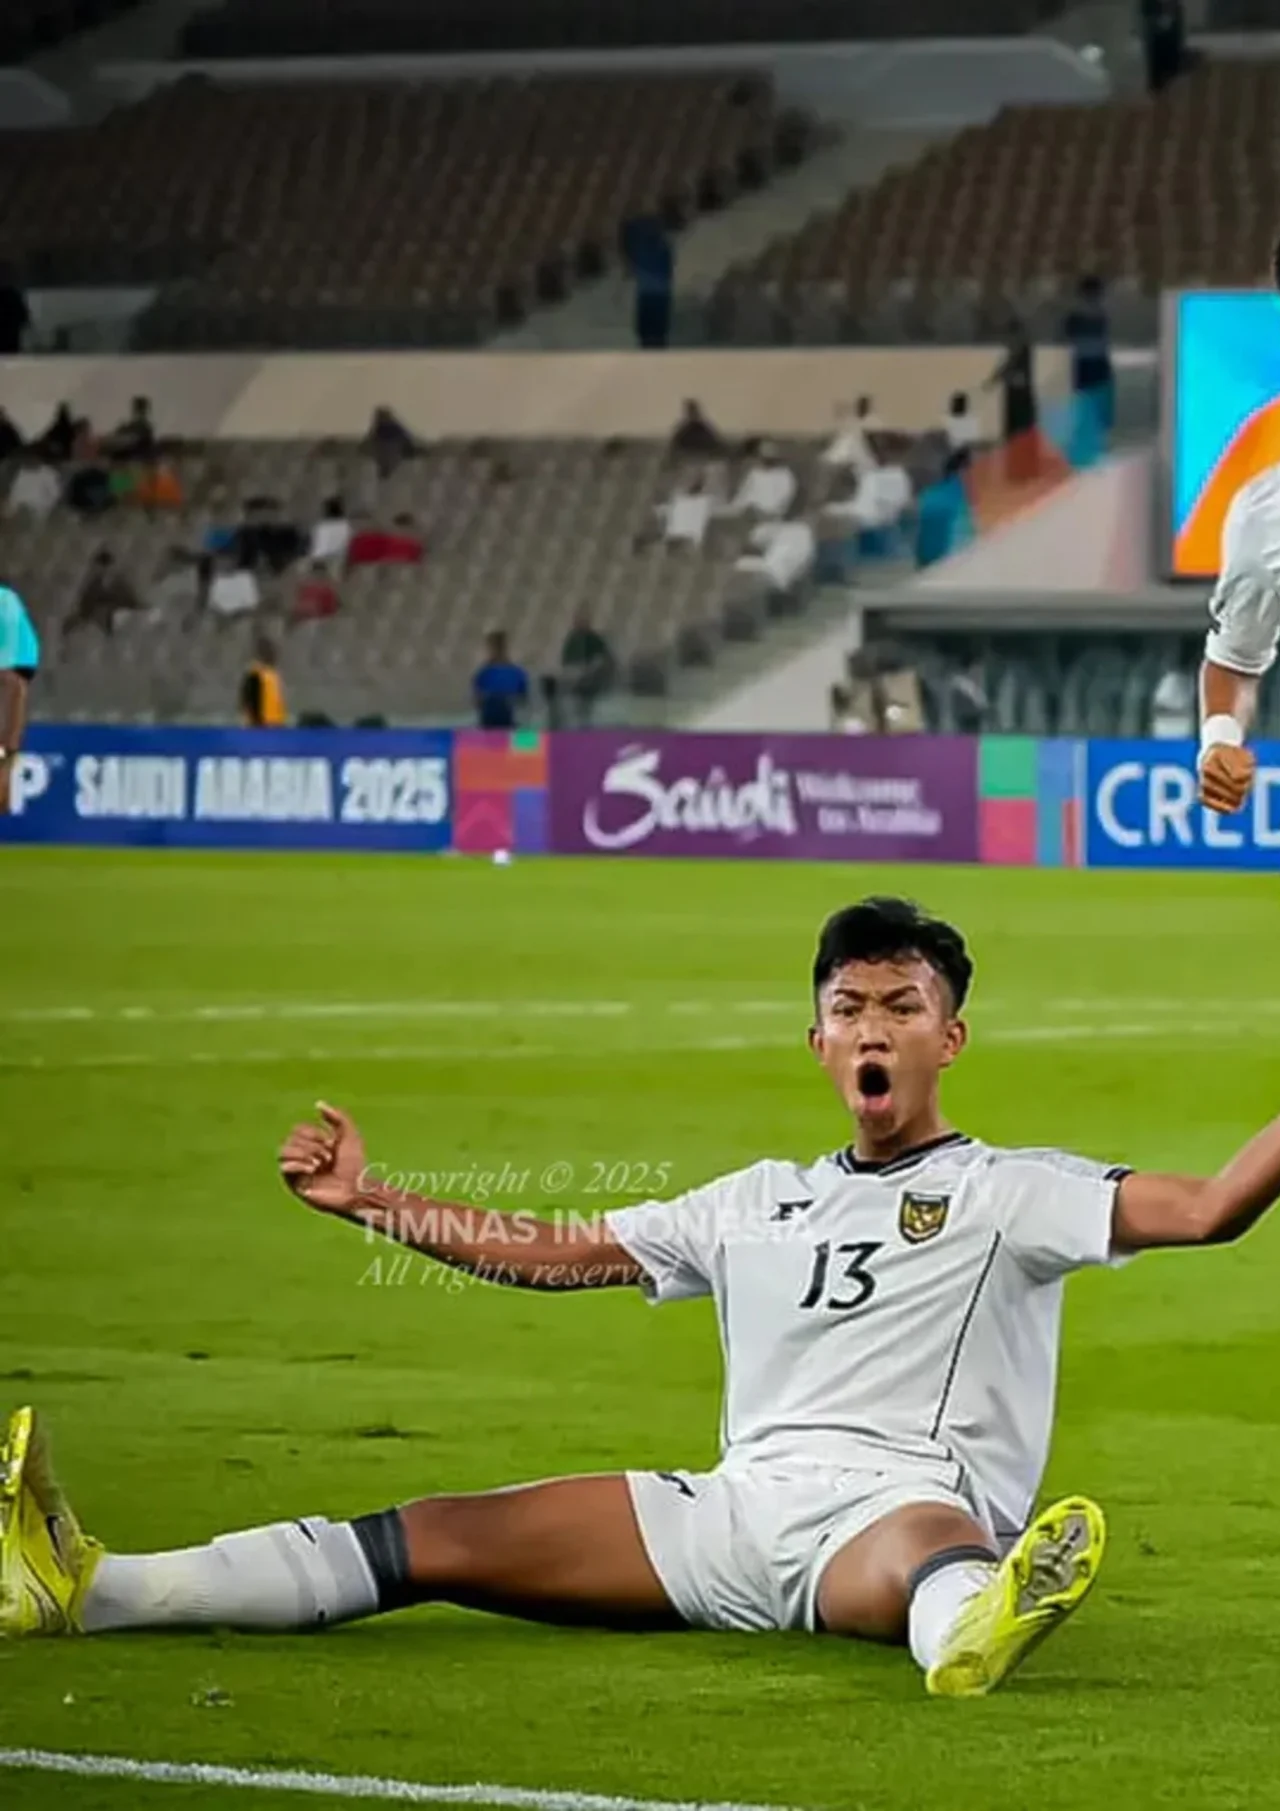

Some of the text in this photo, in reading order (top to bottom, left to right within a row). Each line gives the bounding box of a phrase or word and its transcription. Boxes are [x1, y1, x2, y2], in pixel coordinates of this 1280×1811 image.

[75, 755, 187, 819] SAUDI
[194, 756, 333, 822] ARABIA
[340, 757, 449, 824] 2025
[799, 1240, 887, 1312] 13
